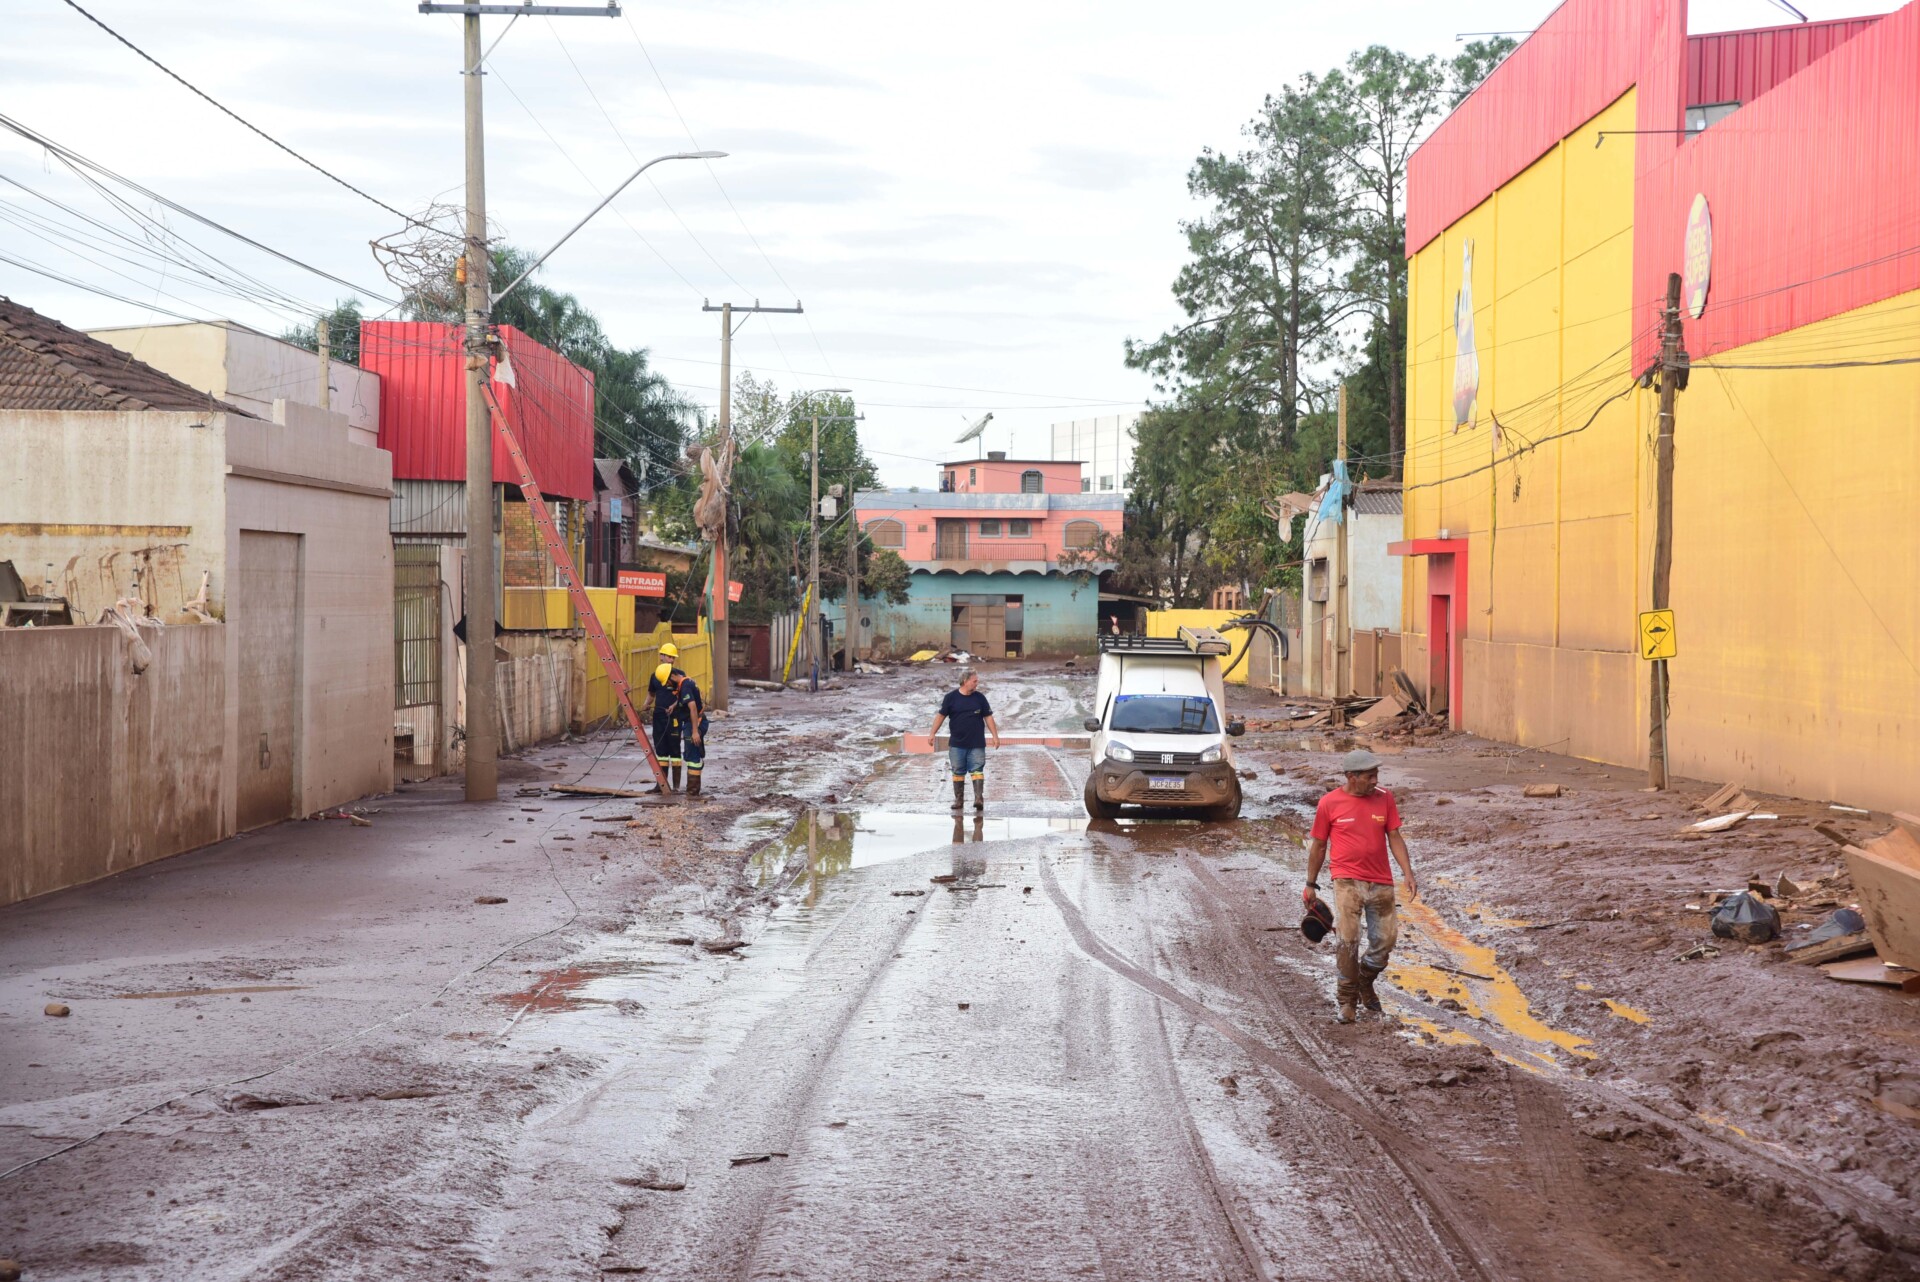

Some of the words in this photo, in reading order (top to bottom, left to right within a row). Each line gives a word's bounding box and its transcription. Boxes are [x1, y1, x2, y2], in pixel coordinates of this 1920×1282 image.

[1685, 253, 1709, 288] SUPER
[620, 576, 664, 586] ENTRADA
[619, 584, 664, 592] ESTACIONAMENTO
[1161, 754, 1174, 764] FIAT
